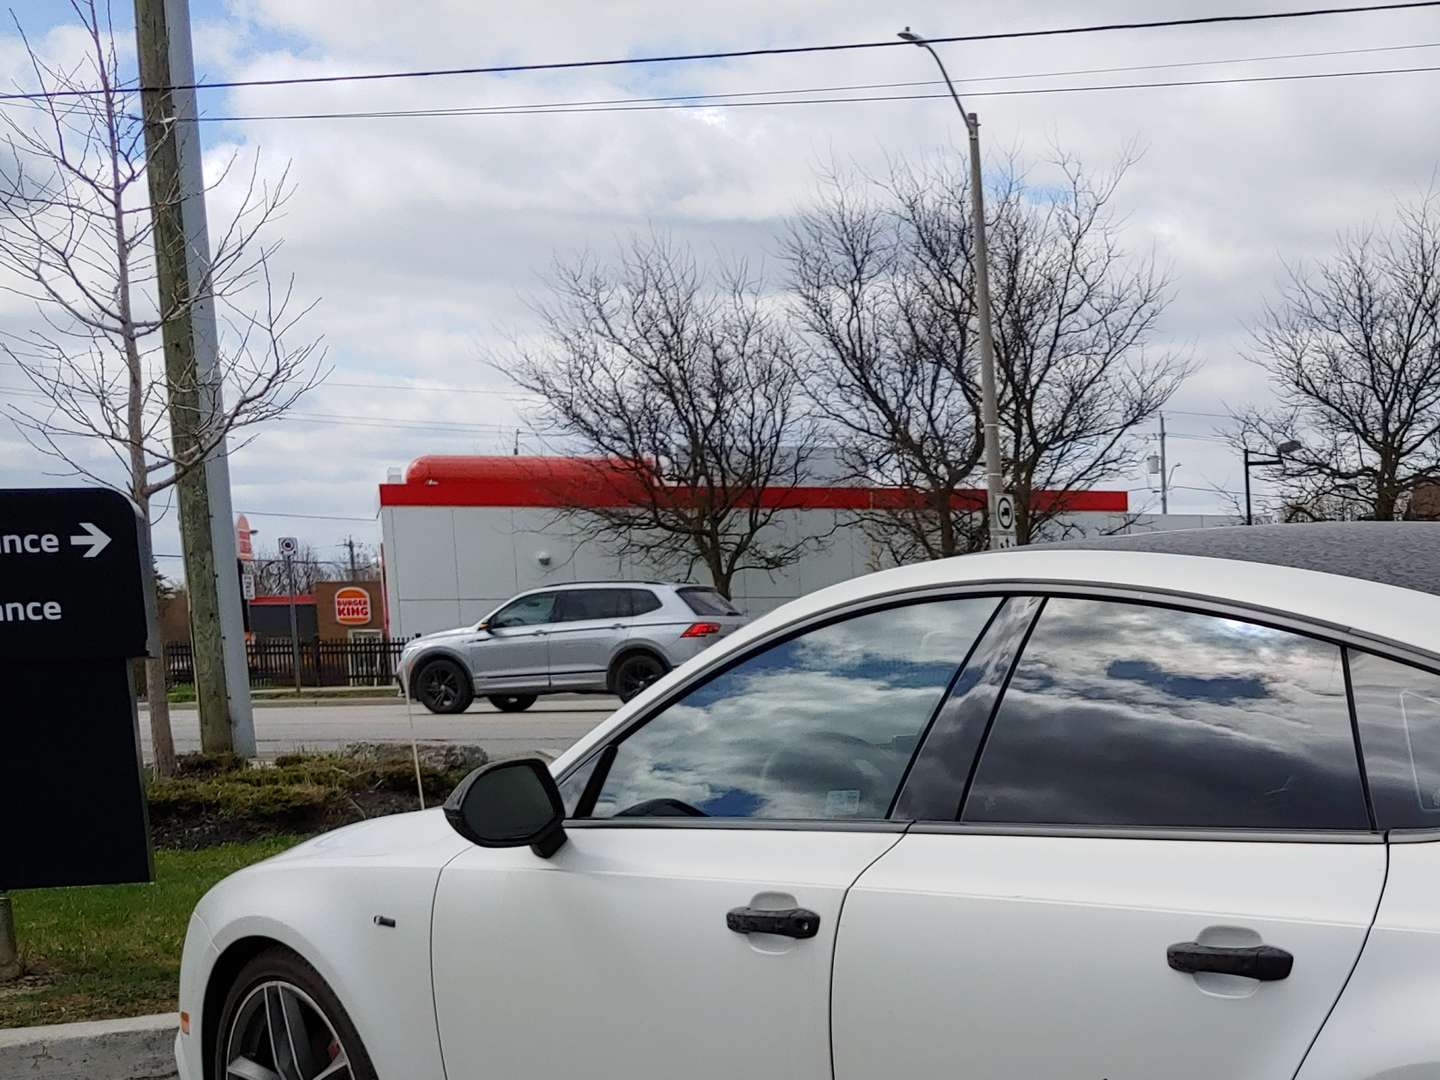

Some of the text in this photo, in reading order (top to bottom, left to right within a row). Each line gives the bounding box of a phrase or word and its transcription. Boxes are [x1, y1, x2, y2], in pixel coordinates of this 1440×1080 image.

[0, 534, 60, 554] nce
[0, 601, 62, 621] nce
[337, 607, 369, 616] KING
